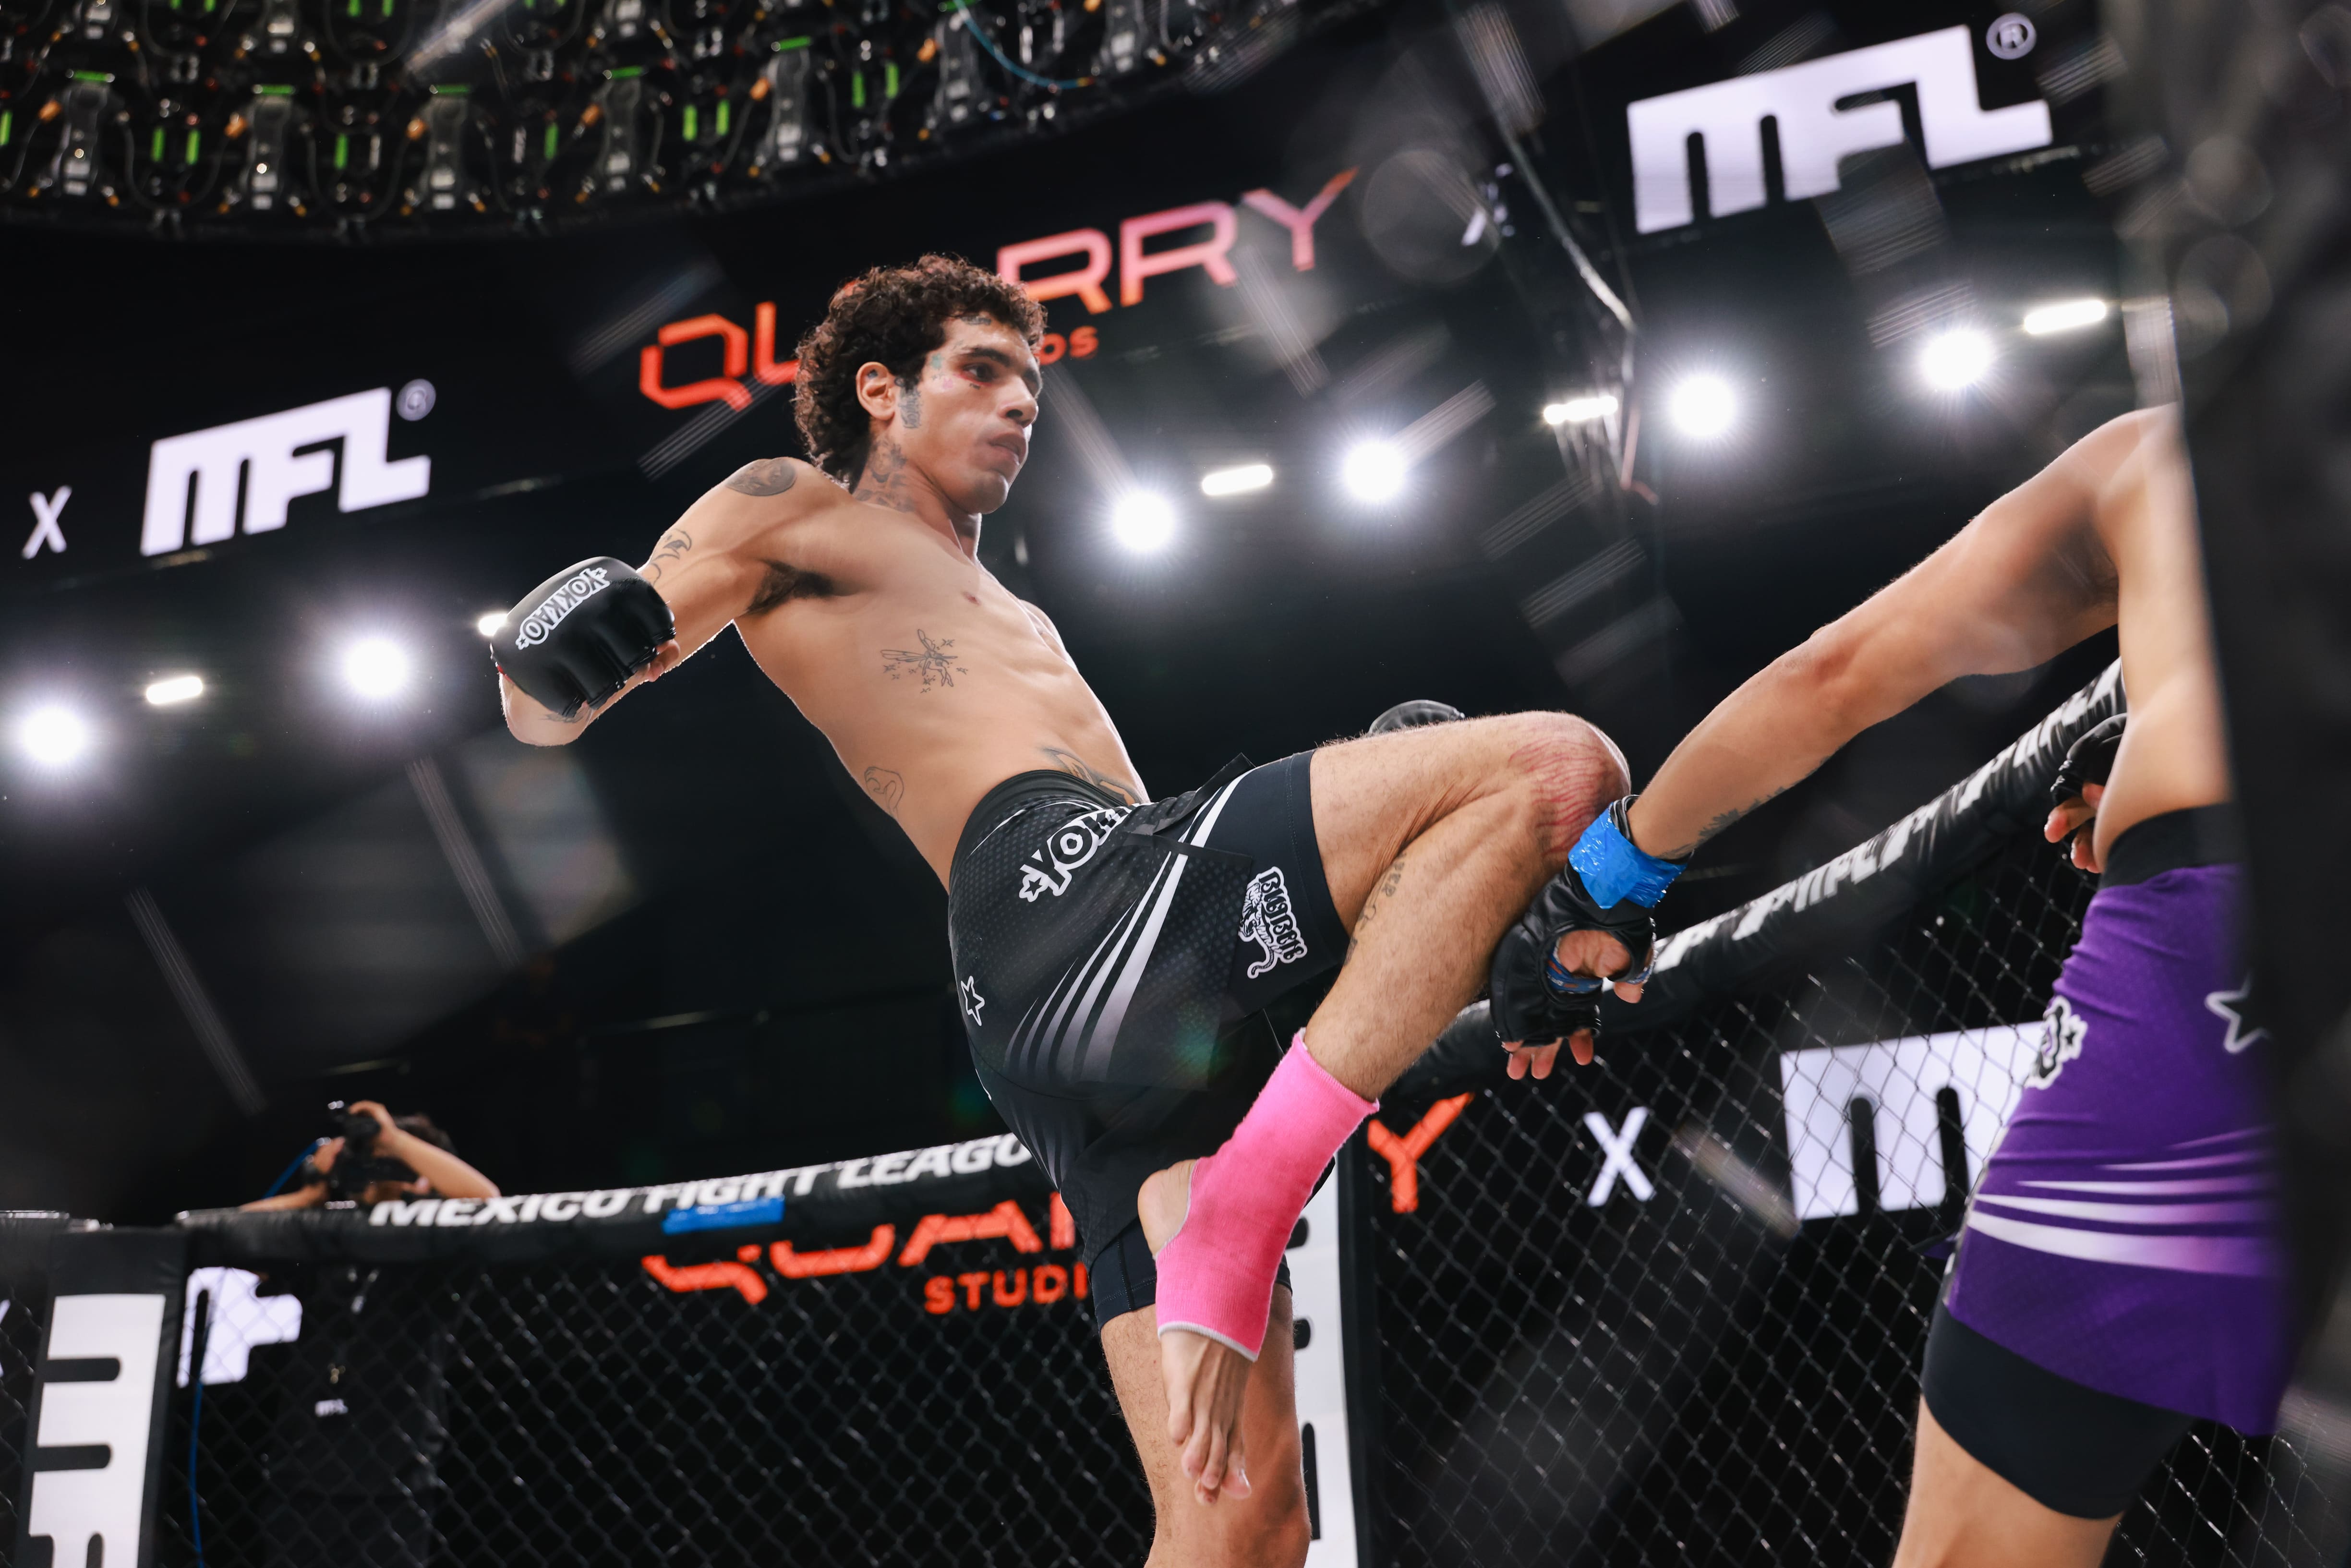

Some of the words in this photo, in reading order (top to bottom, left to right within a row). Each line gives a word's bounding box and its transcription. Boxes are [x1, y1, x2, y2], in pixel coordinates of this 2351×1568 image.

[1628, 24, 2052, 233] MFL
[639, 166, 1360, 412] QURRY
[140, 386, 431, 556] MFL
[519, 568, 611, 645] YOKKAO
[1019, 808, 1131, 896] YOK
[369, 1189, 630, 1226] MEXICO
[642, 1164, 831, 1213] FIGHT
[836, 1132, 1033, 1190] LEAGU
[925, 1262, 1089, 1315] STUDI
